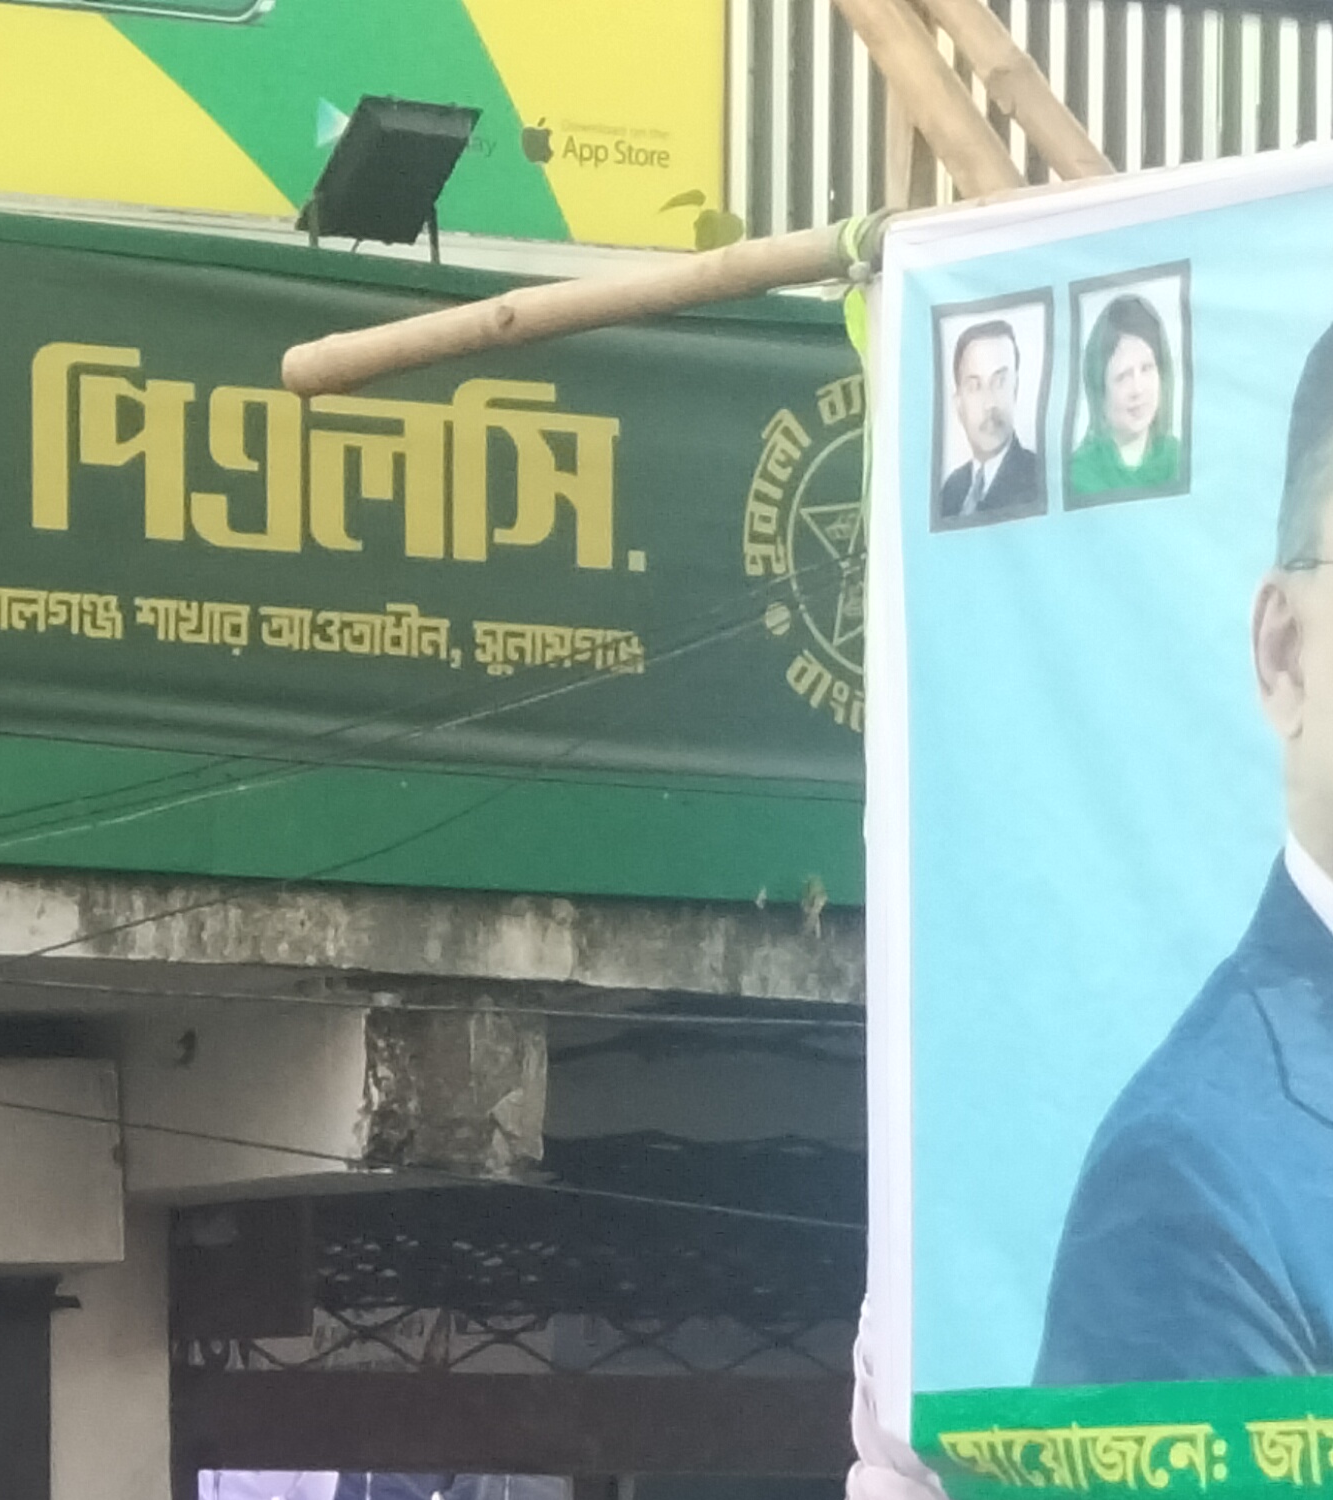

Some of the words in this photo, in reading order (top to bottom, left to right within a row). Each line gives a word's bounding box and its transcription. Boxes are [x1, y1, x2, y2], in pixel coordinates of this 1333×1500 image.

[562, 135, 609, 167] App
[614, 140, 671, 169] Store
[30, 342, 649, 573] পিএলসি.
[135, 596, 251, 656] শাখার
[259, 603, 463, 669] আওতাধীন,
[1244, 1413, 1333, 1487] জা
